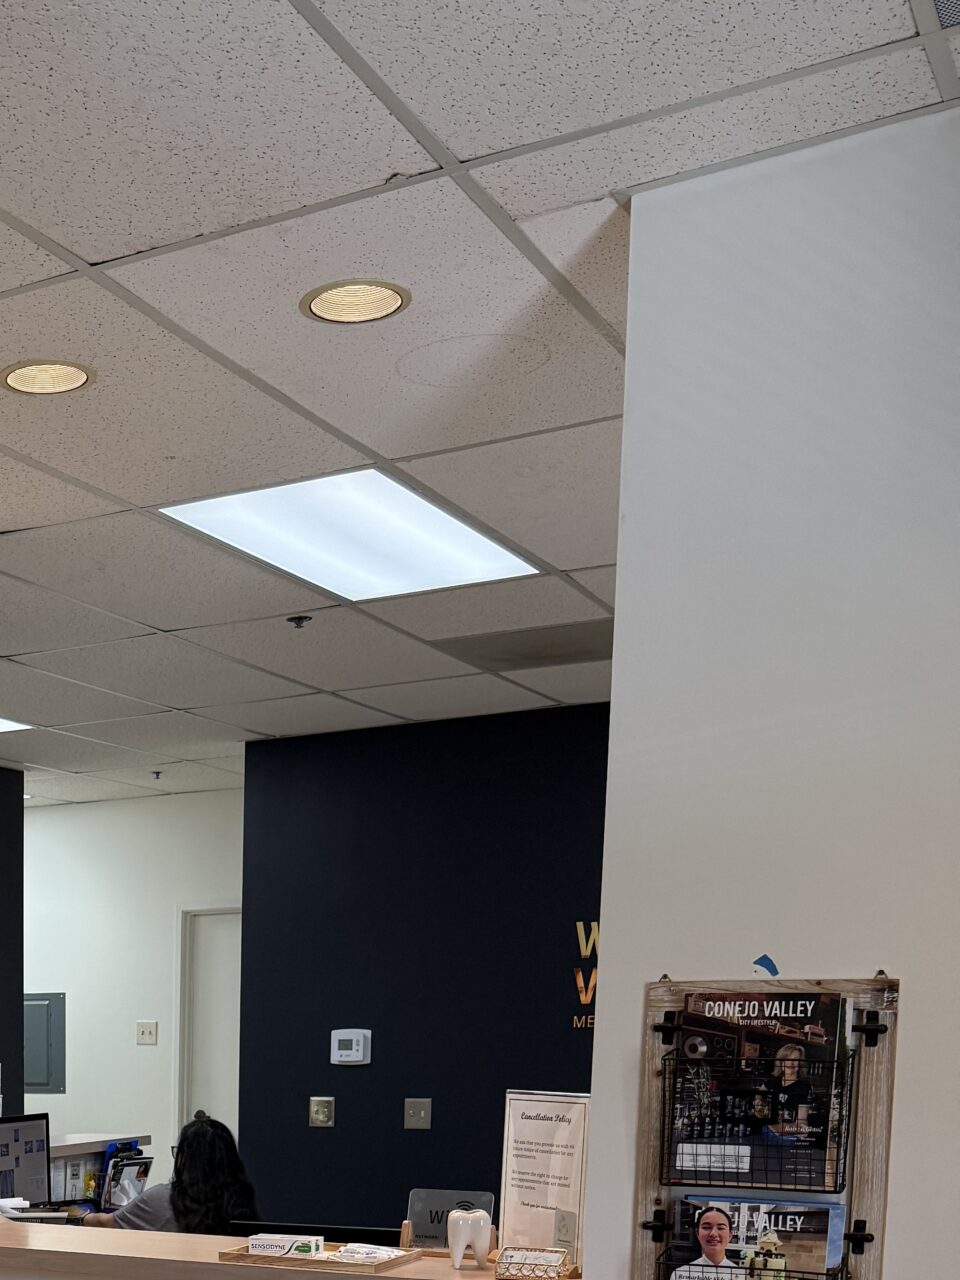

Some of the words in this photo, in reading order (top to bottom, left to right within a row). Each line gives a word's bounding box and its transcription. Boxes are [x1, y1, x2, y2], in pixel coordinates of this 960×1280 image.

[704, 1001, 759, 1018] CONEJO
[763, 1000, 816, 1017] VALLEY
[520, 1111, 553, 1122] Cancellation
[554, 1114, 572, 1126] Policy
[753, 1211, 805, 1232] VALLEY
[251, 1243, 286, 1251] SENSODYNE
